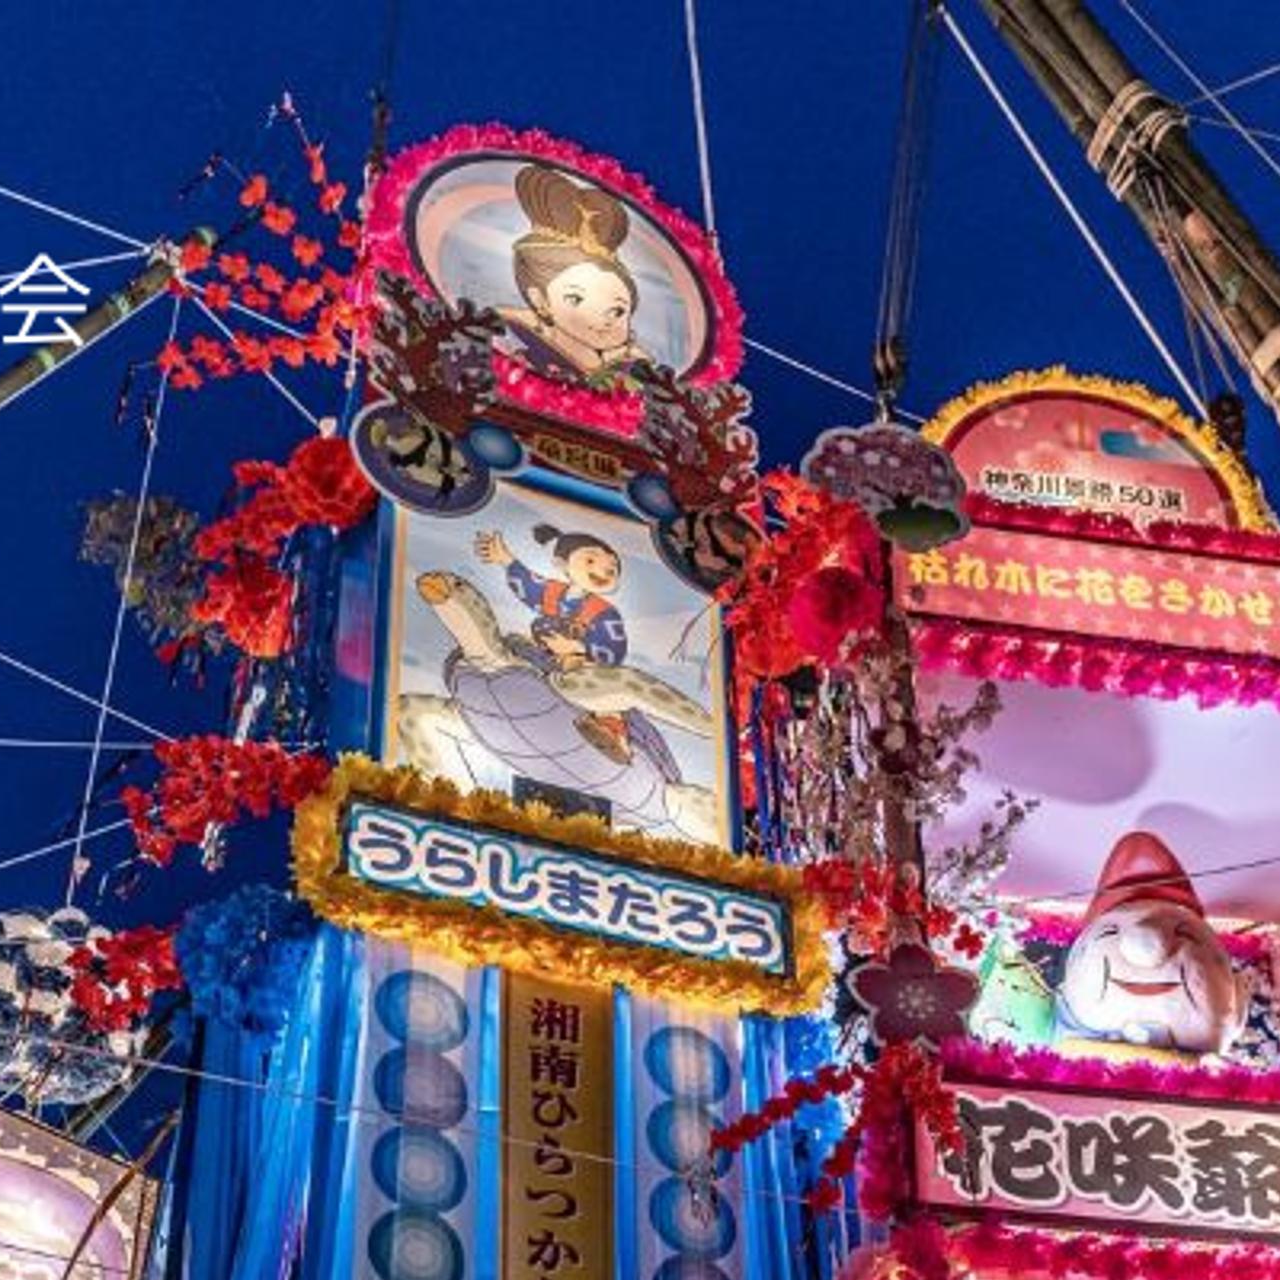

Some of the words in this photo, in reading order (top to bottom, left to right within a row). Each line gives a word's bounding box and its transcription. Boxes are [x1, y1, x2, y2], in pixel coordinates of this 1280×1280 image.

[354, 812, 786, 964] うらしまたろう
